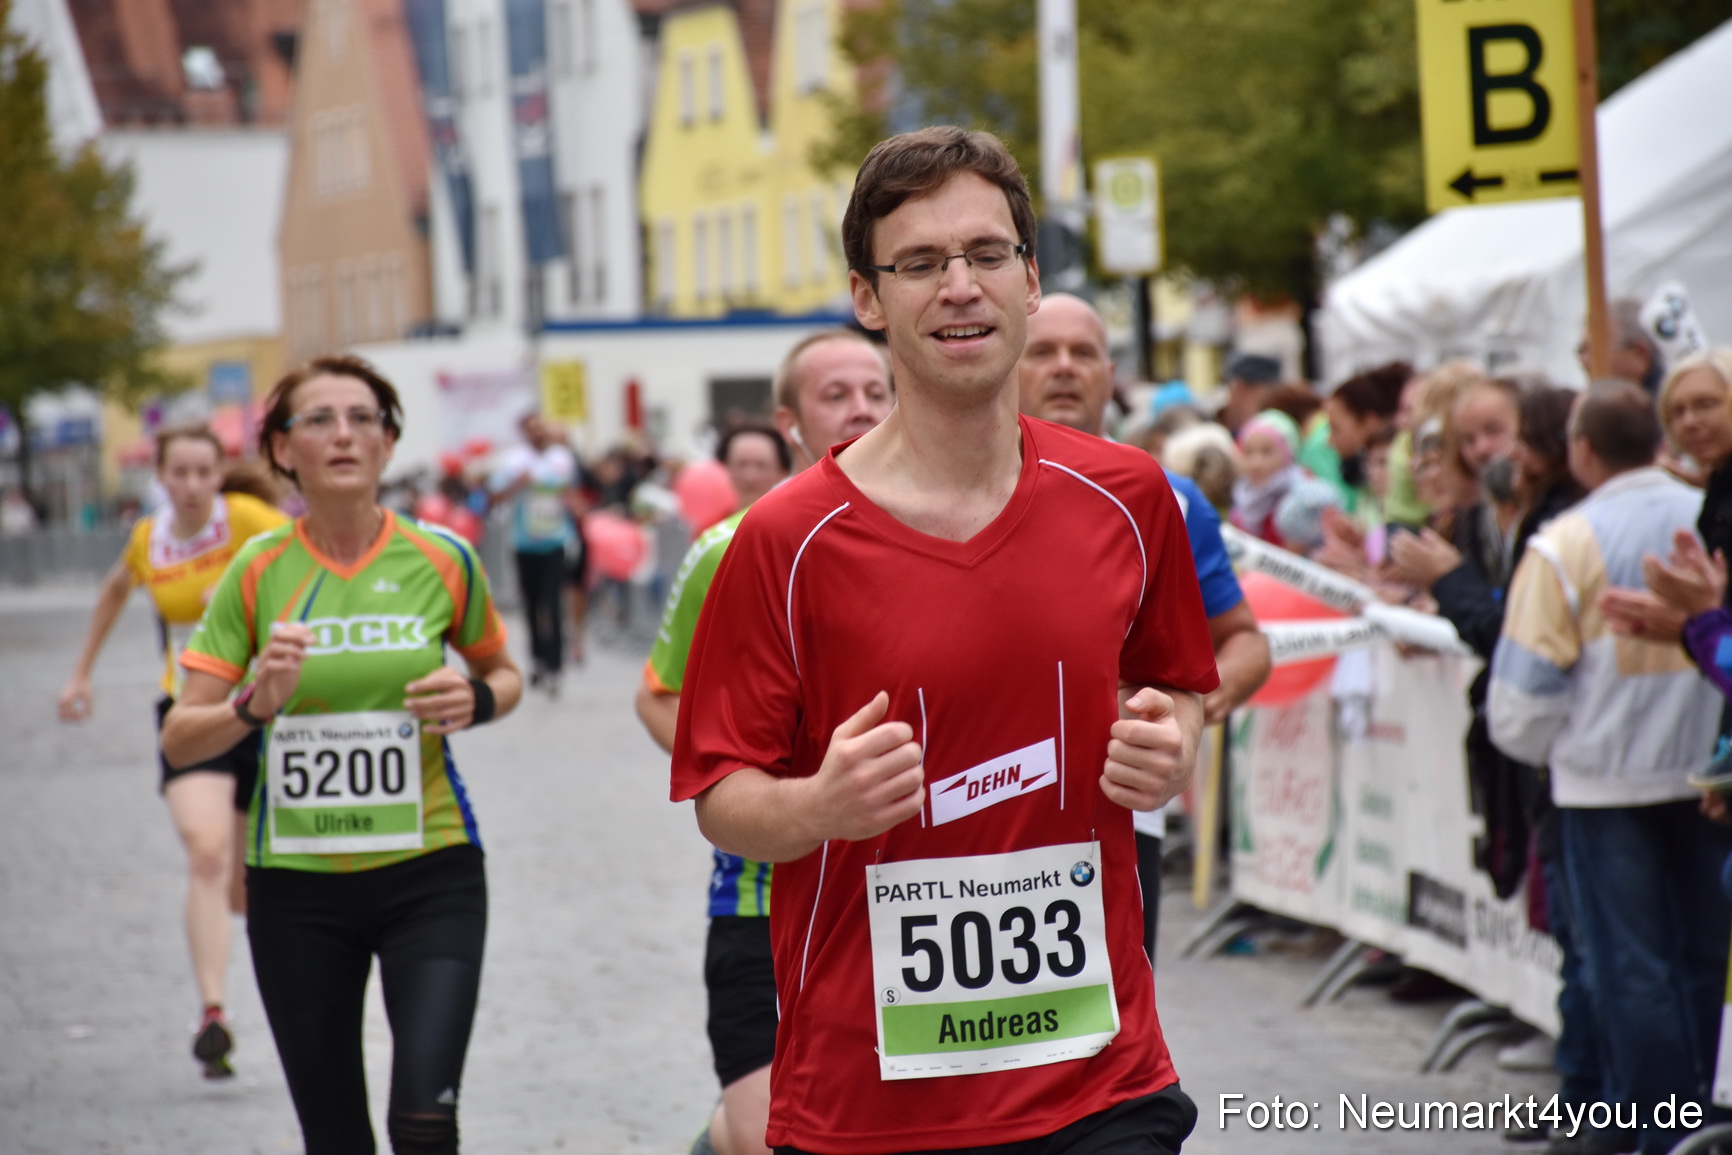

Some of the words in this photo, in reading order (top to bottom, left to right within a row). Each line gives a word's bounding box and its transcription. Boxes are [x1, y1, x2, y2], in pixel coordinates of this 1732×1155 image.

[1467, 23, 1551, 146] B
[270, 613, 429, 656] OCK
[283, 747, 406, 800] 5200
[967, 764, 1021, 801] DEHN
[314, 814, 374, 832] Ulrike
[875, 881, 953, 903] PARTL
[958, 870, 1062, 898] Neumarkt
[901, 899, 1086, 993] 5033
[886, 989, 895, 1003] S
[938, 1009, 1059, 1044] Andreas
